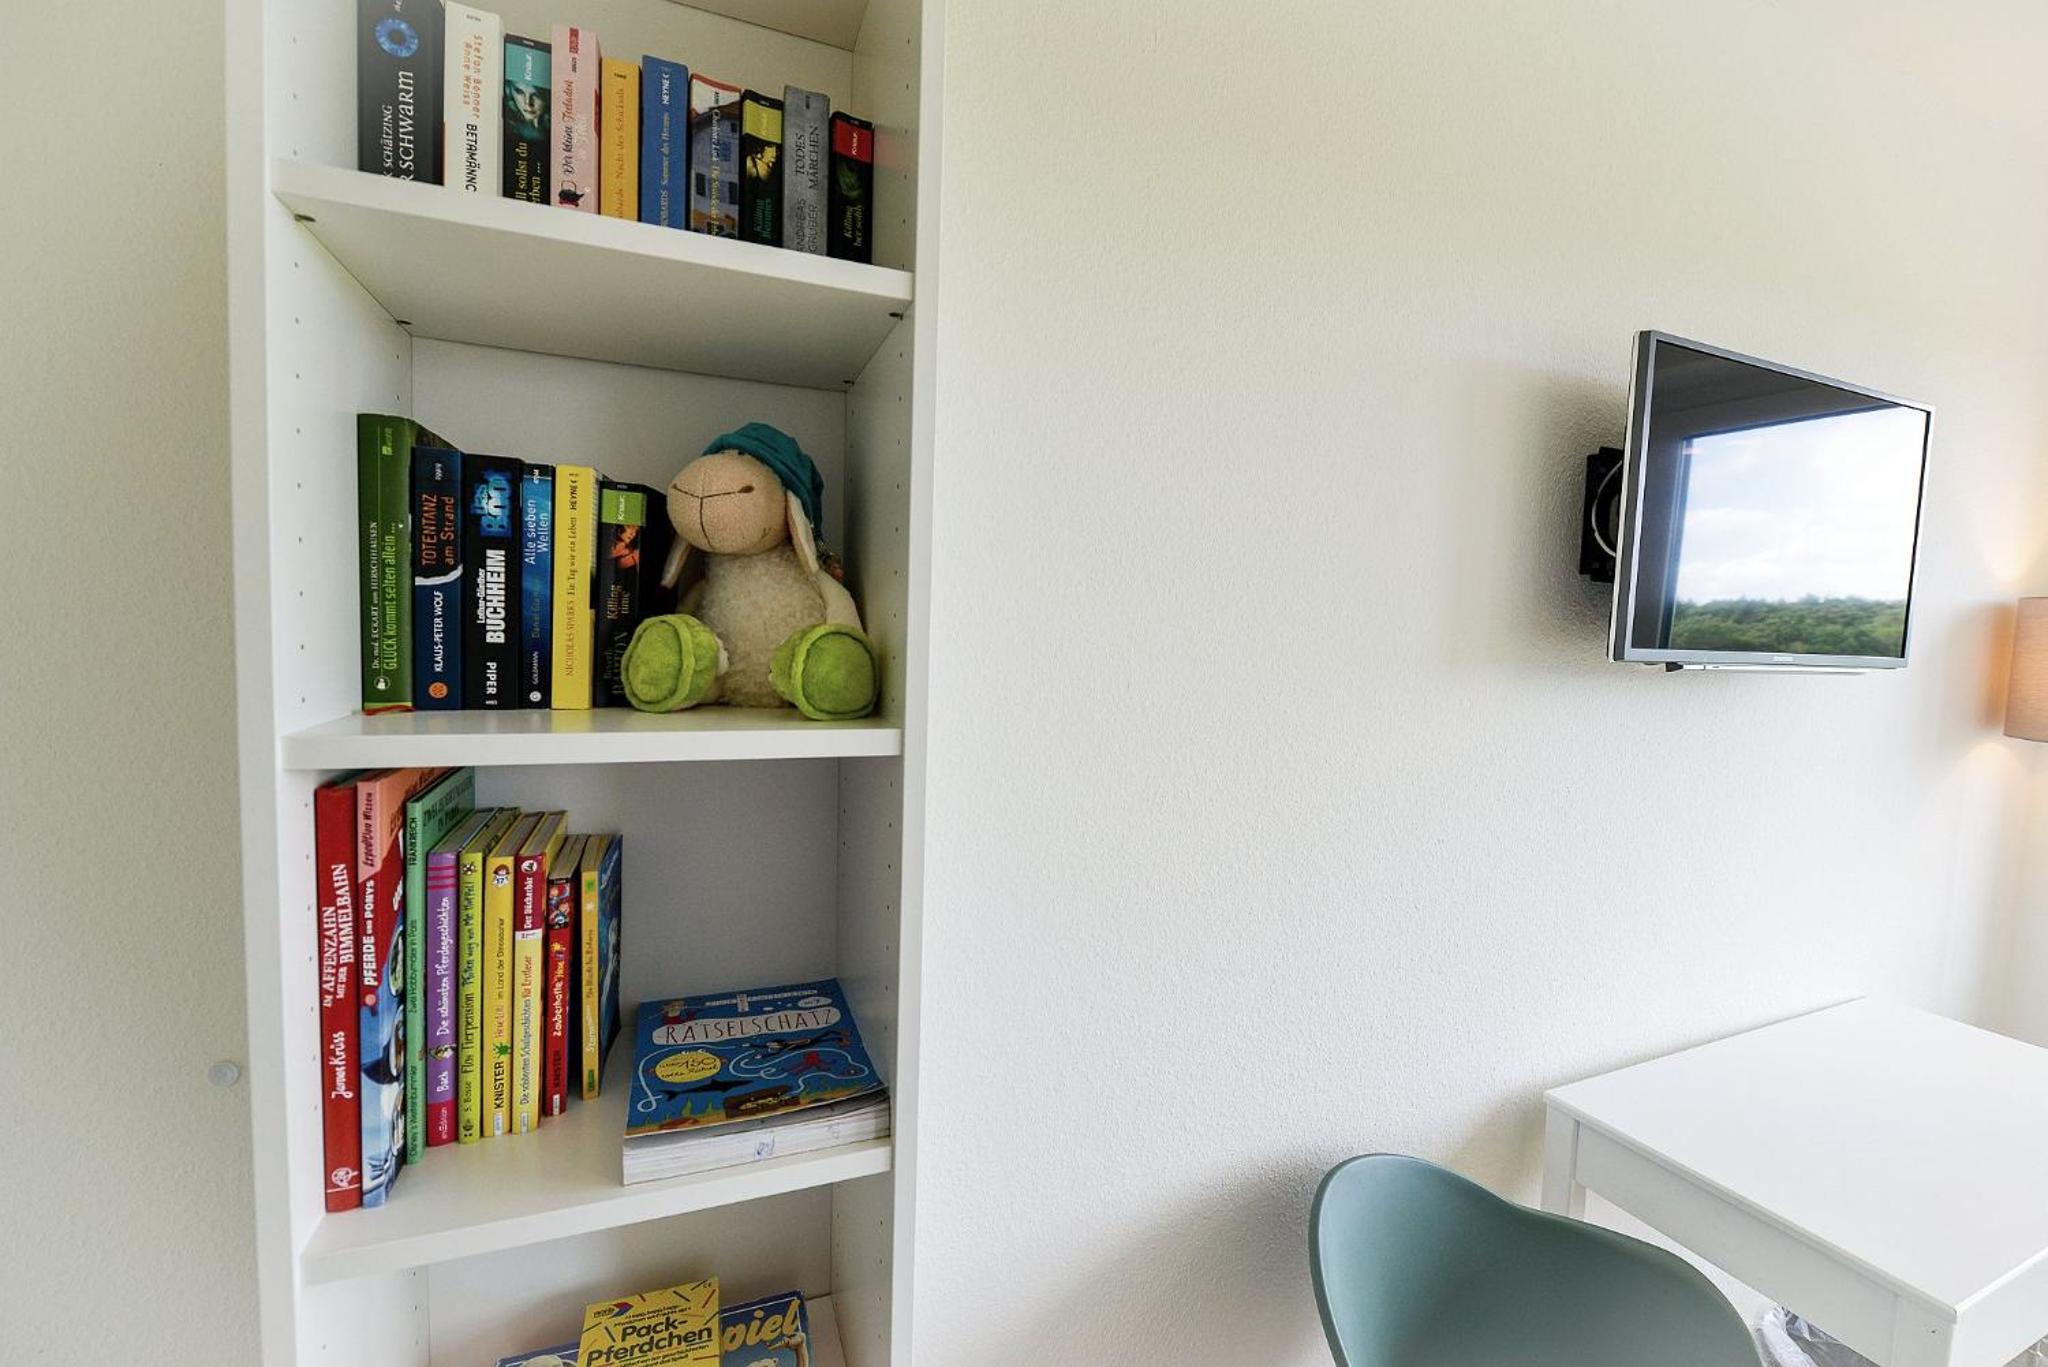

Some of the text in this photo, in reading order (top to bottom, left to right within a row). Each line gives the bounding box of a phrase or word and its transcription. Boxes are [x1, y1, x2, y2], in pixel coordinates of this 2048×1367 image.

[463, 41, 472, 70] Anne
[473, 33, 483, 74] Stefan
[471, 77, 481, 119] Bonner
[662, 79, 671, 105] HEYNE
[465, 123, 480, 192] BETAMÄNNC
[516, 141, 528, 158] du
[795, 133, 807, 176] TODES
[806, 125, 820, 190] MÄRCHEN
[529, 176, 541, 202] rben
[568, 484, 578, 511] HEYNE
[421, 494, 438, 566] TOTENTANZ
[440, 496, 455, 566] am Strand
[524, 499, 537, 566] Alle sieben
[536, 512, 549, 553] Wellen
[567, 517, 576, 538] Leben
[369, 521, 379, 590] HIRSCHHAUSEN
[382, 535, 396, 566] allein
[383, 567, 397, 599] selten
[567, 568, 578, 581] Tag
[485, 549, 506, 644] BUCHHEIM
[370, 606, 379, 639] ECKART
[384, 601, 398, 636] kommt
[433, 590, 444, 672] KLAUS-PETER WOLF
[566, 632, 575, 677] NICHOLAS
[486, 661, 498, 695] PIPER
[408, 817, 418, 866] FRANKREICH
[331, 863, 355, 965] BIMMELBAHN
[364, 879, 375, 919] PONYS
[321, 905, 338, 992] AFFENZAHN
[362, 936, 379, 987] PFERDE
[435, 896, 454, 1036] Die schönsten Pferdegeschichten
[496, 959, 505, 970] der
[496, 972, 505, 990] Land
[461, 993, 479, 1050] Tierpension
[664, 1007, 833, 1045] RÄTSELSCHATZ
[436, 1070, 449, 1093] Bach
[494, 1061, 505, 1109] KNISTER
[586, 1326, 713, 1367] Pferdchen
[620, 1316, 688, 1342] Pack-
[722, 1299, 801, 1353] piel
